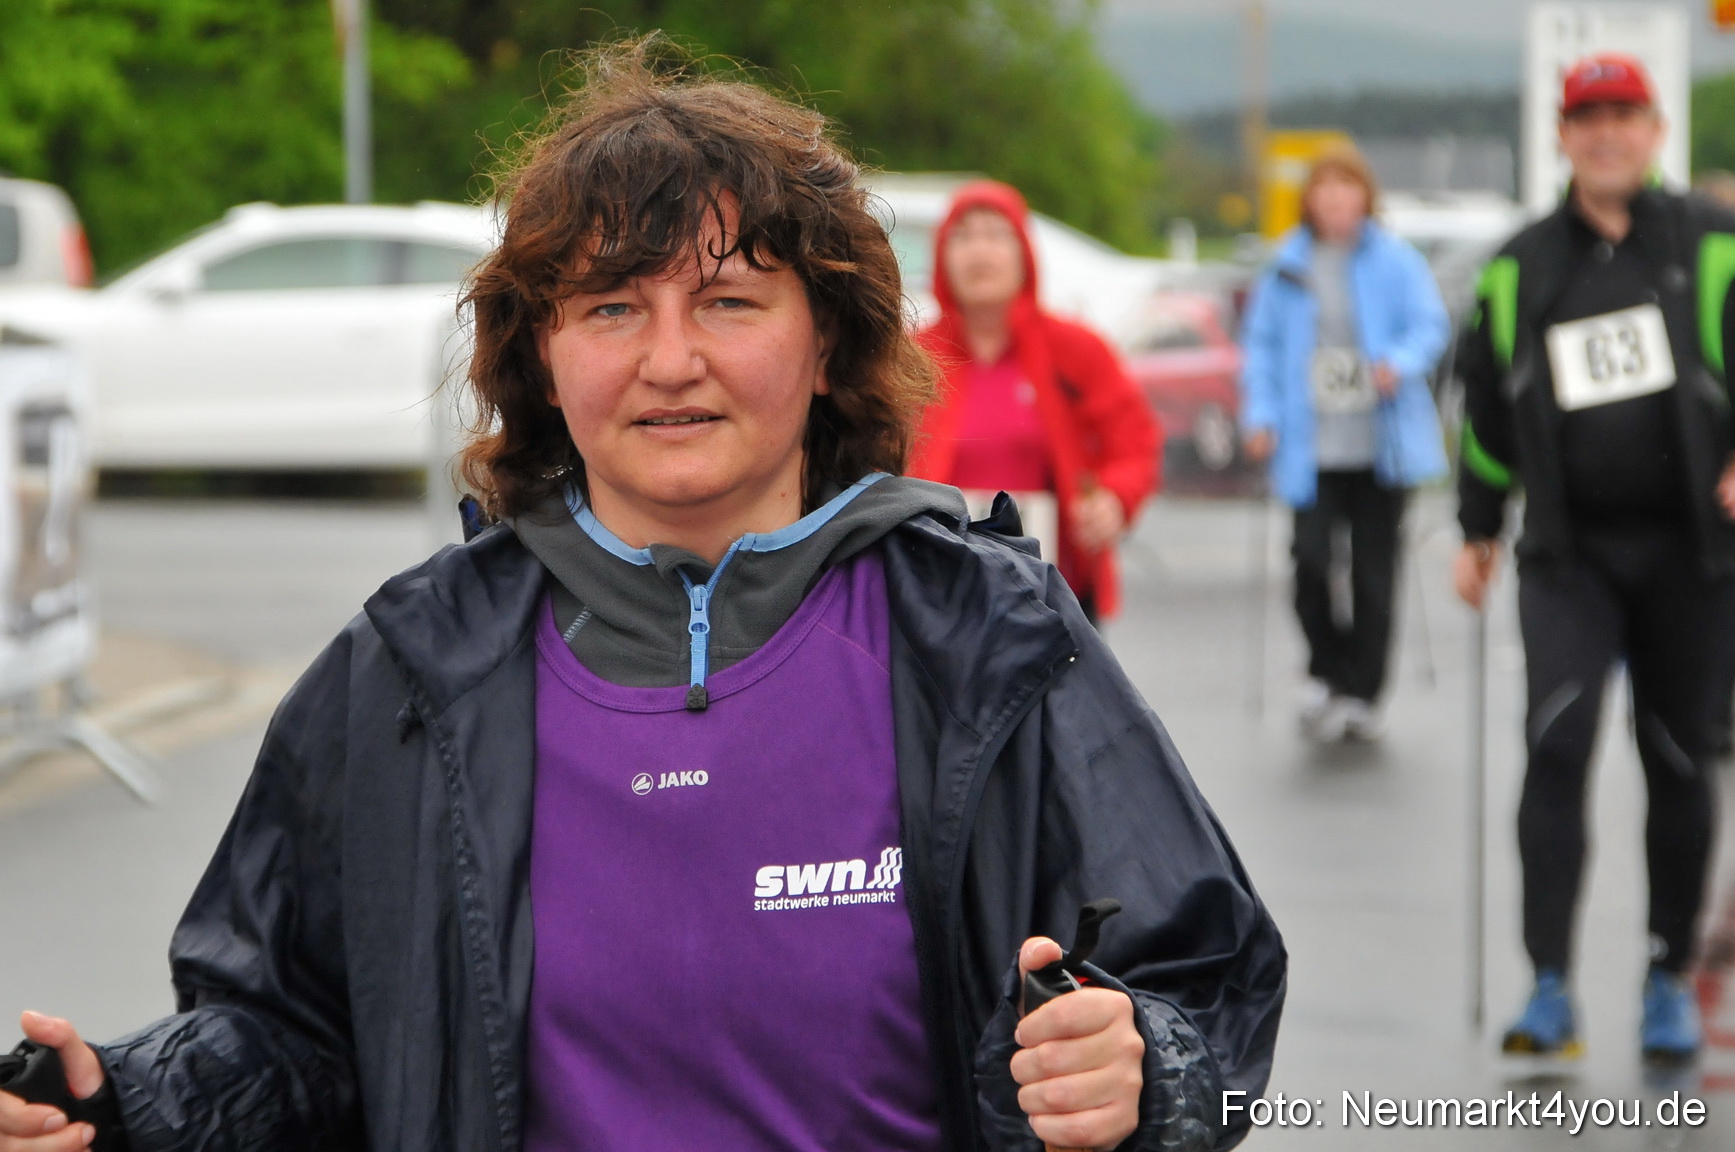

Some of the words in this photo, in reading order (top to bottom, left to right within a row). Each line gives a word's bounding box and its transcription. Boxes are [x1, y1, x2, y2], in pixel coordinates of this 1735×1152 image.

[1585, 325, 1648, 383] 63
[657, 770, 709, 789] JAKO
[754, 859, 867, 898] swn
[754, 895, 829, 911] stadtwerke
[833, 890, 896, 906] neumarkt
